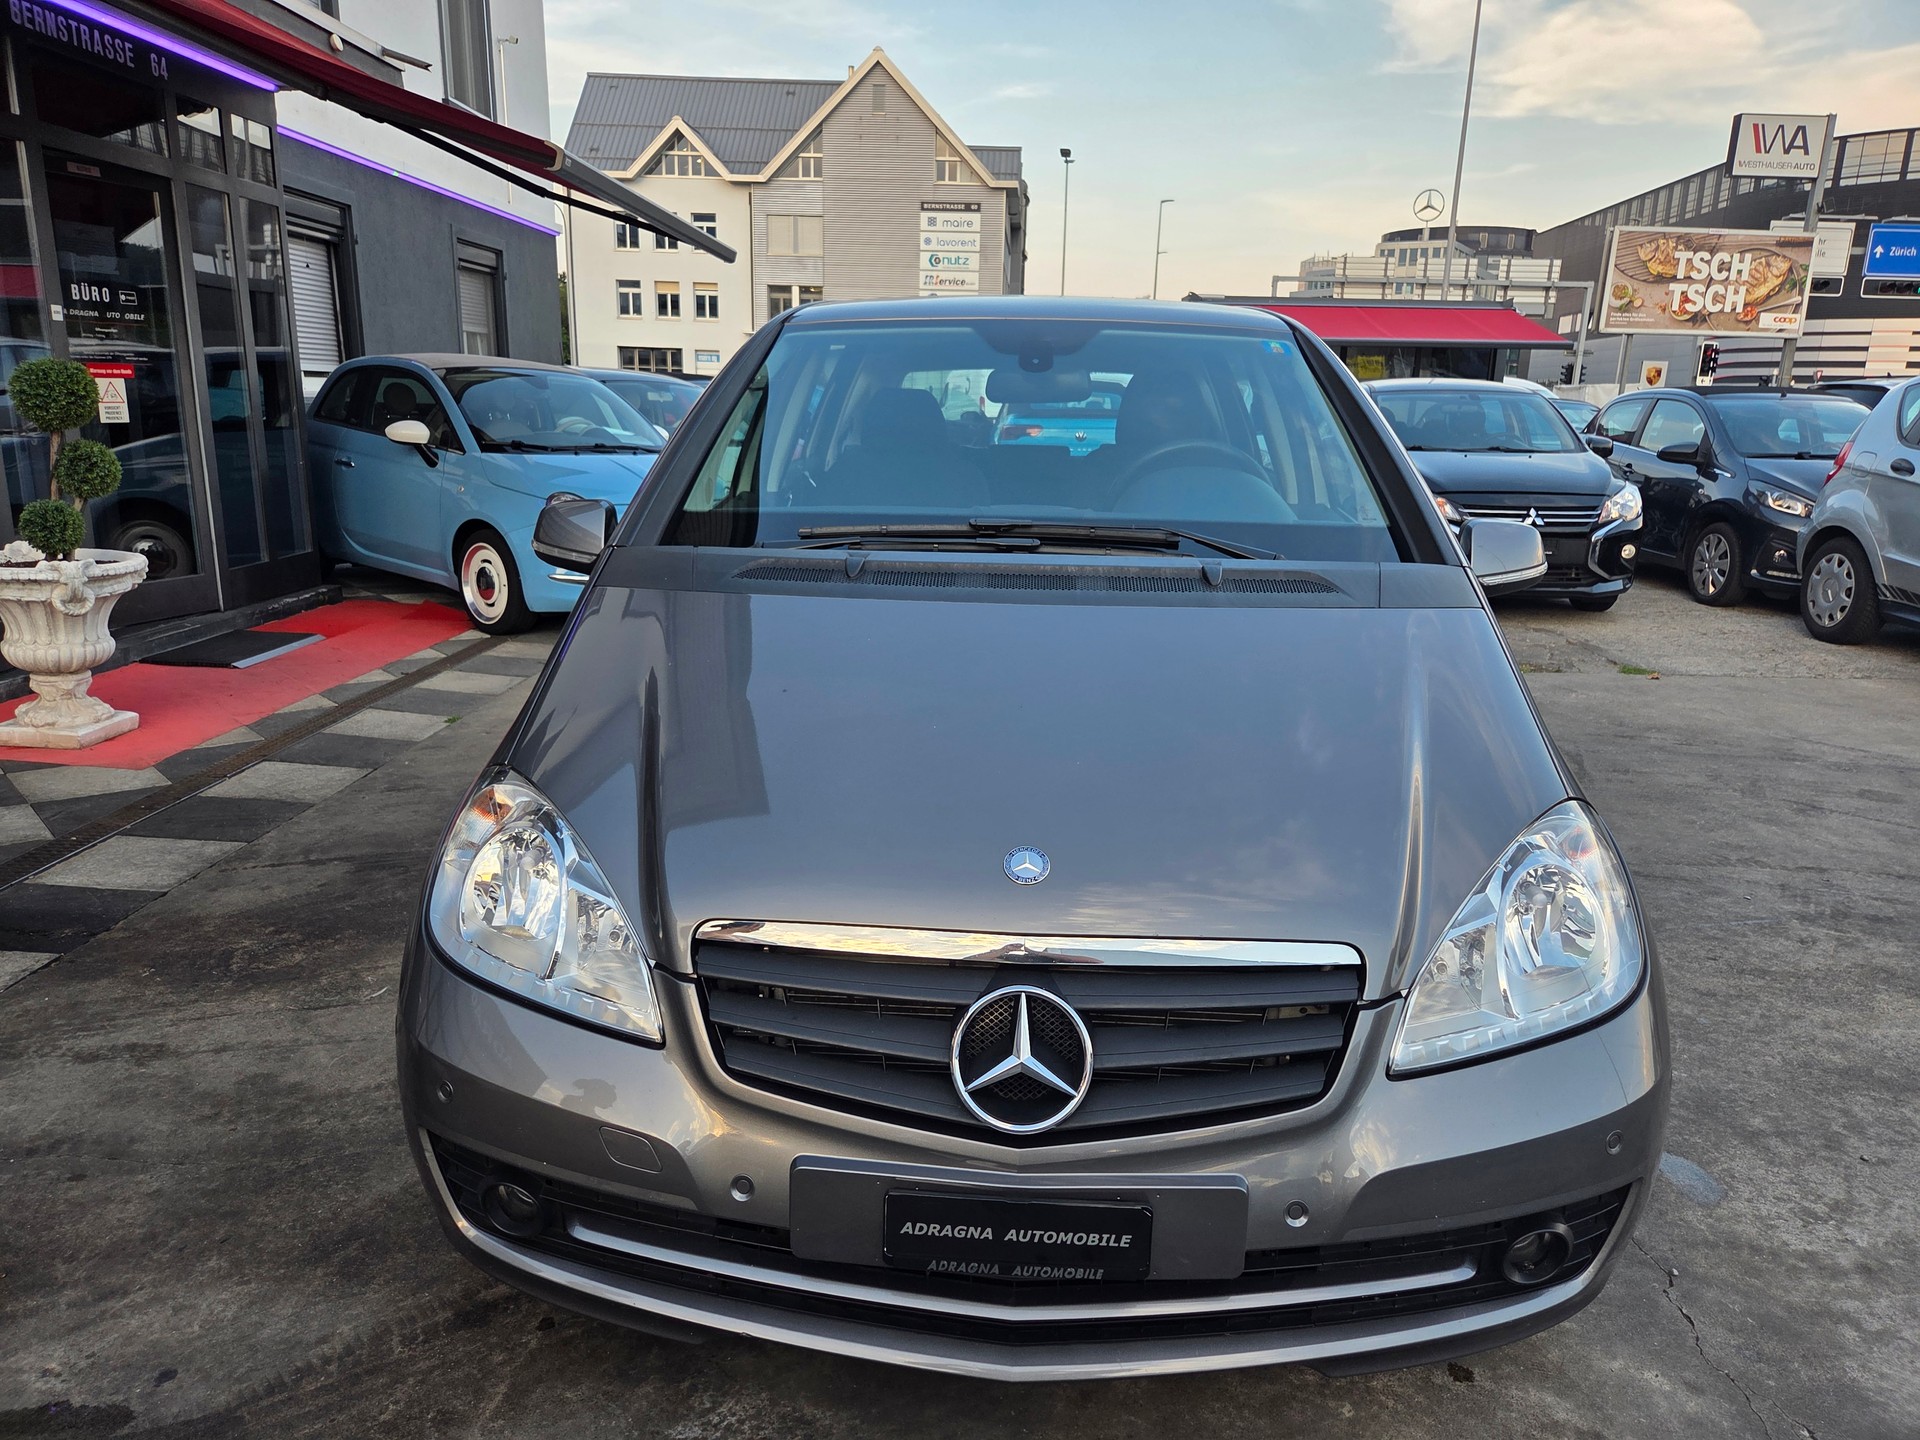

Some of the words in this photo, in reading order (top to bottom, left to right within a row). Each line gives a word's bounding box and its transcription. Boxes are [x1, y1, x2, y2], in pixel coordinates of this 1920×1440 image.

[9, 0, 135, 68] BERNSTRASSE
[150, 52, 169, 80] 64
[942, 217, 974, 228] maire
[937, 237, 977, 247] lavorent
[1889, 246, 1917, 257] Zürich
[1674, 251, 1752, 280] TSCH
[71, 282, 110, 303] BÜRO
[1669, 283, 1747, 313] TSCH
[1773, 316, 1797, 325] coop
[900, 1221, 994, 1240] ADRAGNA
[1003, 1228, 1133, 1248] AUTOMOBILE
[927, 1259, 1000, 1275] ADRAGNA
[1011, 1264, 1105, 1280] AUTOMOBILE
